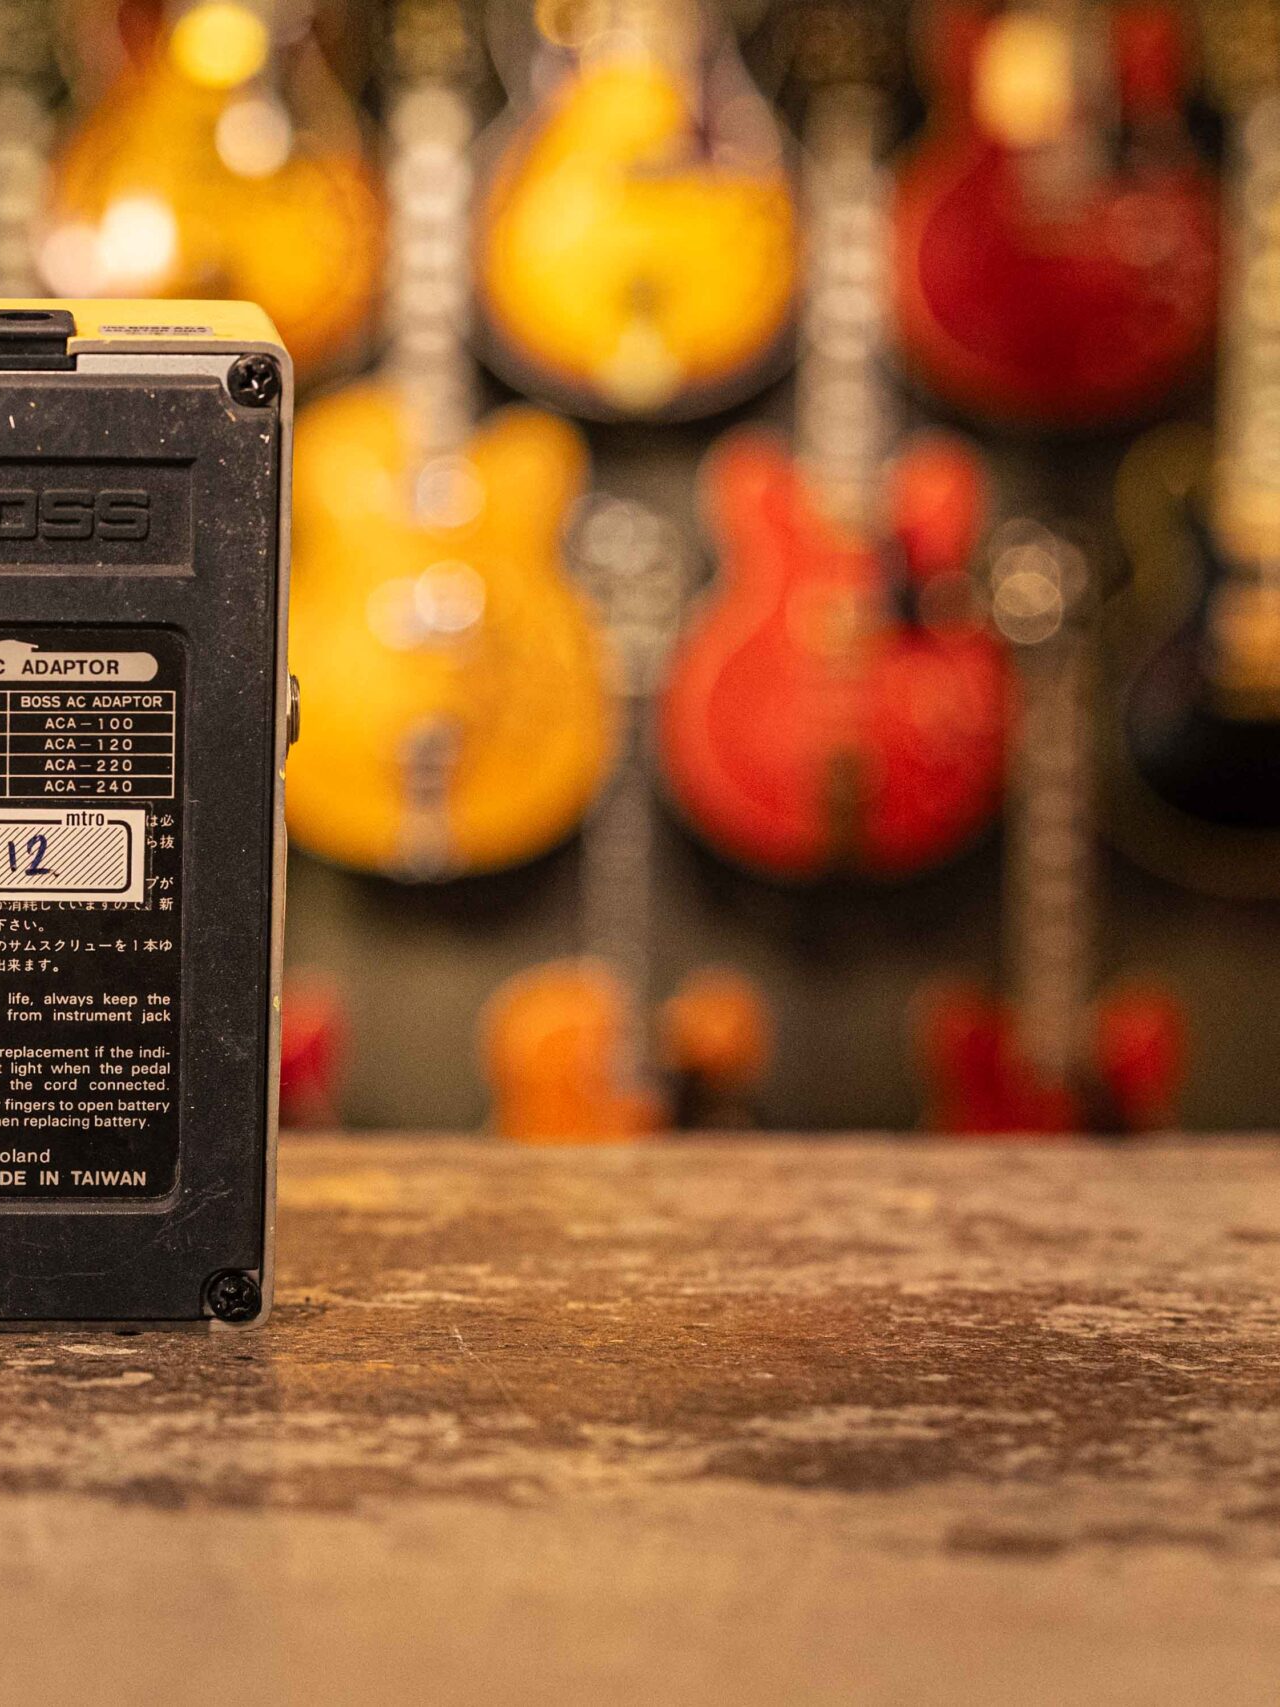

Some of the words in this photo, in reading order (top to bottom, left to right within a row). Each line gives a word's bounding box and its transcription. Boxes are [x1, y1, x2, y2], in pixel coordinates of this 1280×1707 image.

[21, 659, 119, 675] ADAPTOR
[20, 696, 61, 708] BOSS
[66, 696, 87, 708] AC
[92, 696, 164, 709] ADAPTOR
[66, 811, 106, 827] mtro
[8, 992, 34, 1006] life,
[43, 992, 94, 1007] always
[103, 992, 138, 1008] keep
[147, 992, 171, 1006] the
[7, 1008, 43, 1021] from
[53, 1008, 132, 1022] instrument
[141, 1009, 171, 1024] jack
[0, 1045, 90, 1060] replacement
[94, 1045, 105, 1058] if
[110, 1046, 134, 1059] the
[139, 1046, 171, 1058] indi-
[10, 1061, 43, 1077] light
[50, 1062, 90, 1075] when
[99, 1062, 123, 1075] the
[131, 1062, 171, 1077] pedal
[9, 1078, 33, 1091] the
[44, 1078, 78, 1091] cord
[89, 1078, 170, 1091] connected.
[4, 1098, 55, 1114] fingers
[59, 1100, 74, 1111] to
[77, 1101, 114, 1113] open
[118, 1099, 170, 1114] battery
[23, 1114, 90, 1130] replacing
[94, 1114, 150, 1130] battery.
[39, 1170, 59, 1186] IN
[70, 1170, 146, 1186] TAIWAN
